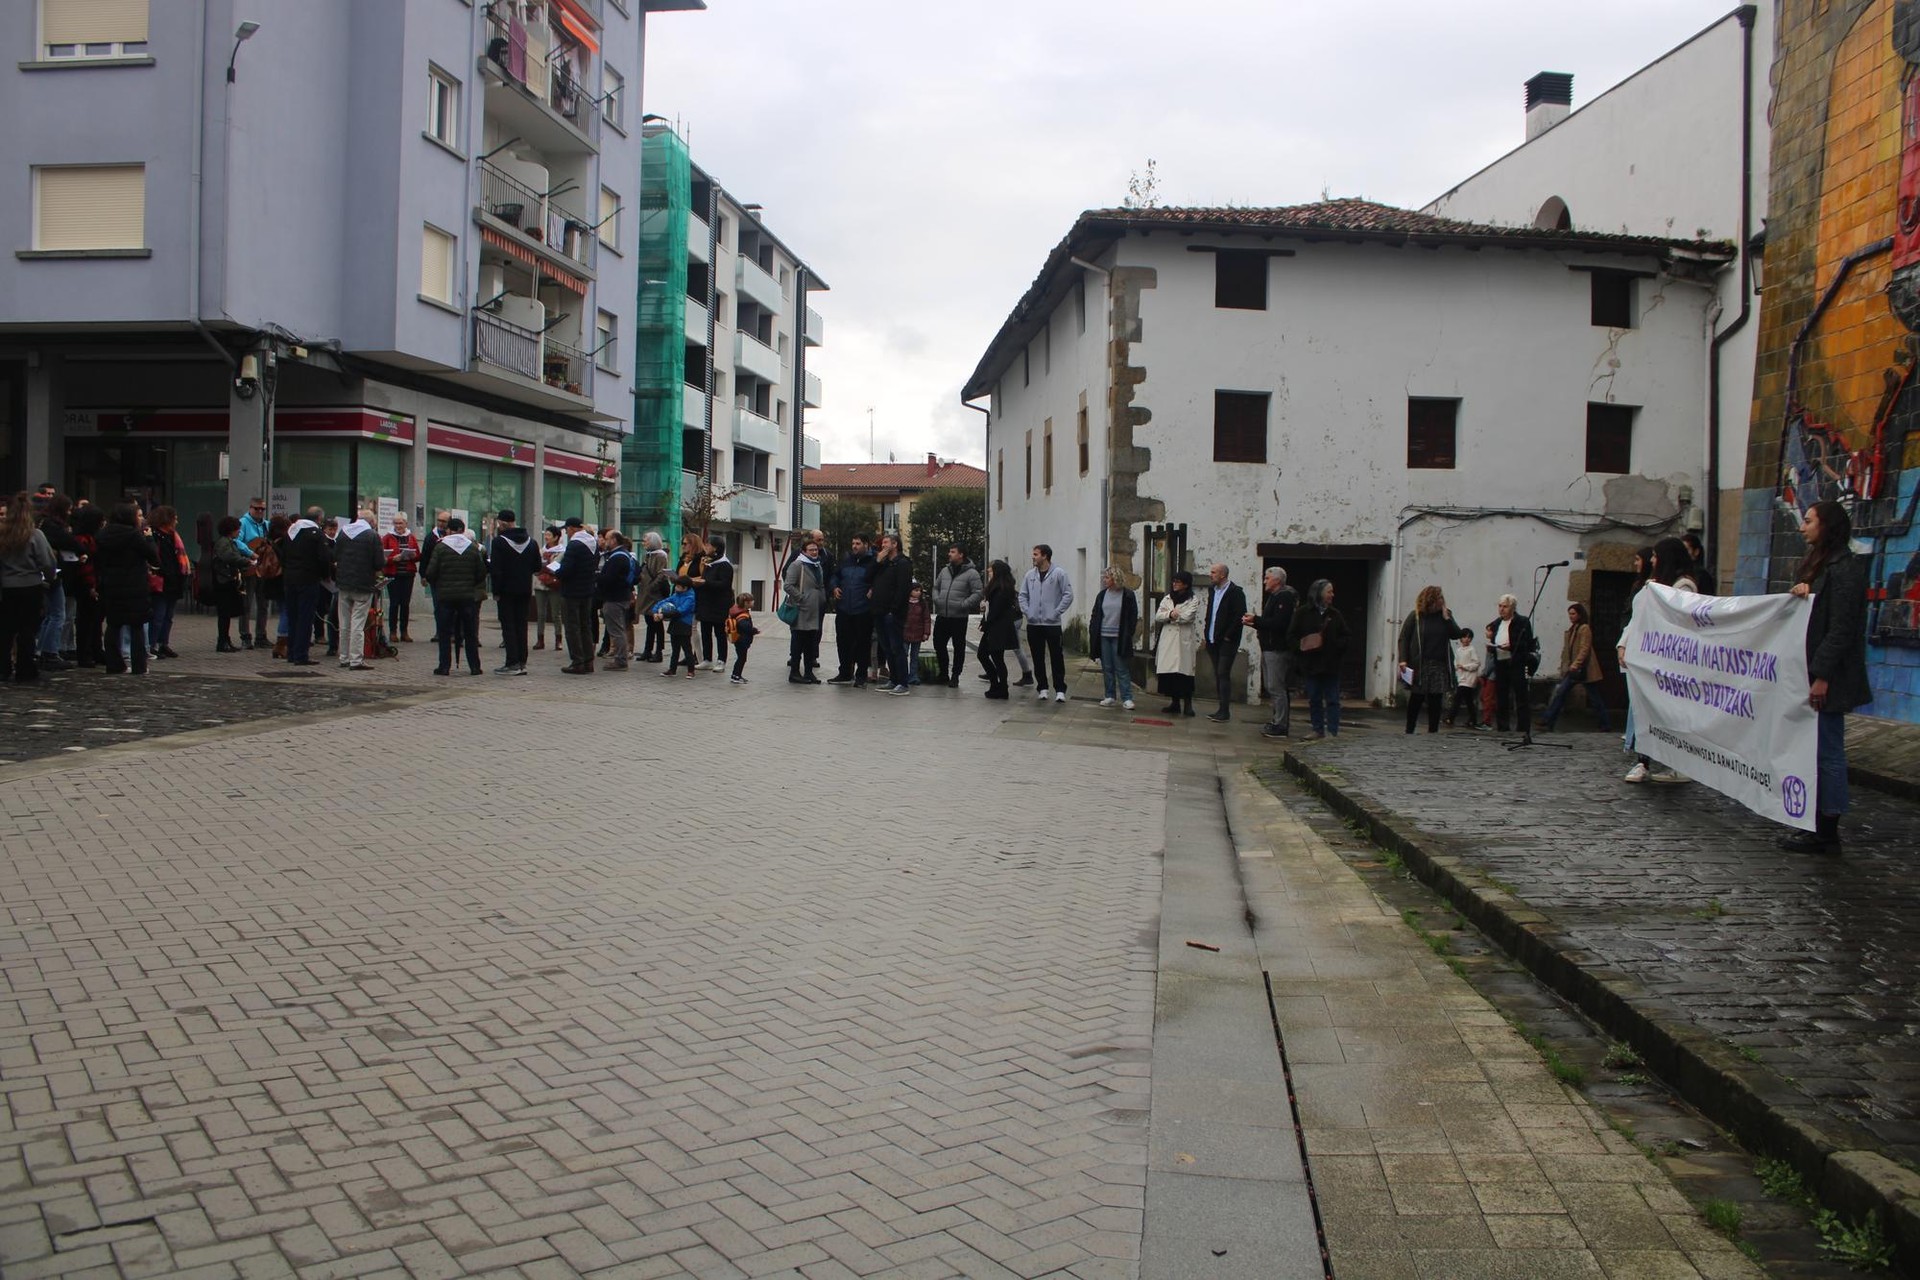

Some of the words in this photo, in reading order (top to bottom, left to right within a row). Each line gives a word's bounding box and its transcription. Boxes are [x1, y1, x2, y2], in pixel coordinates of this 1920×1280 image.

[1640, 631, 1699, 666] INDARKERIA
[1701, 644, 1778, 684] MATXISTARIK
[1653, 669, 1701, 702] GABEKO
[1702, 680, 1755, 720] BIZITZAK!
